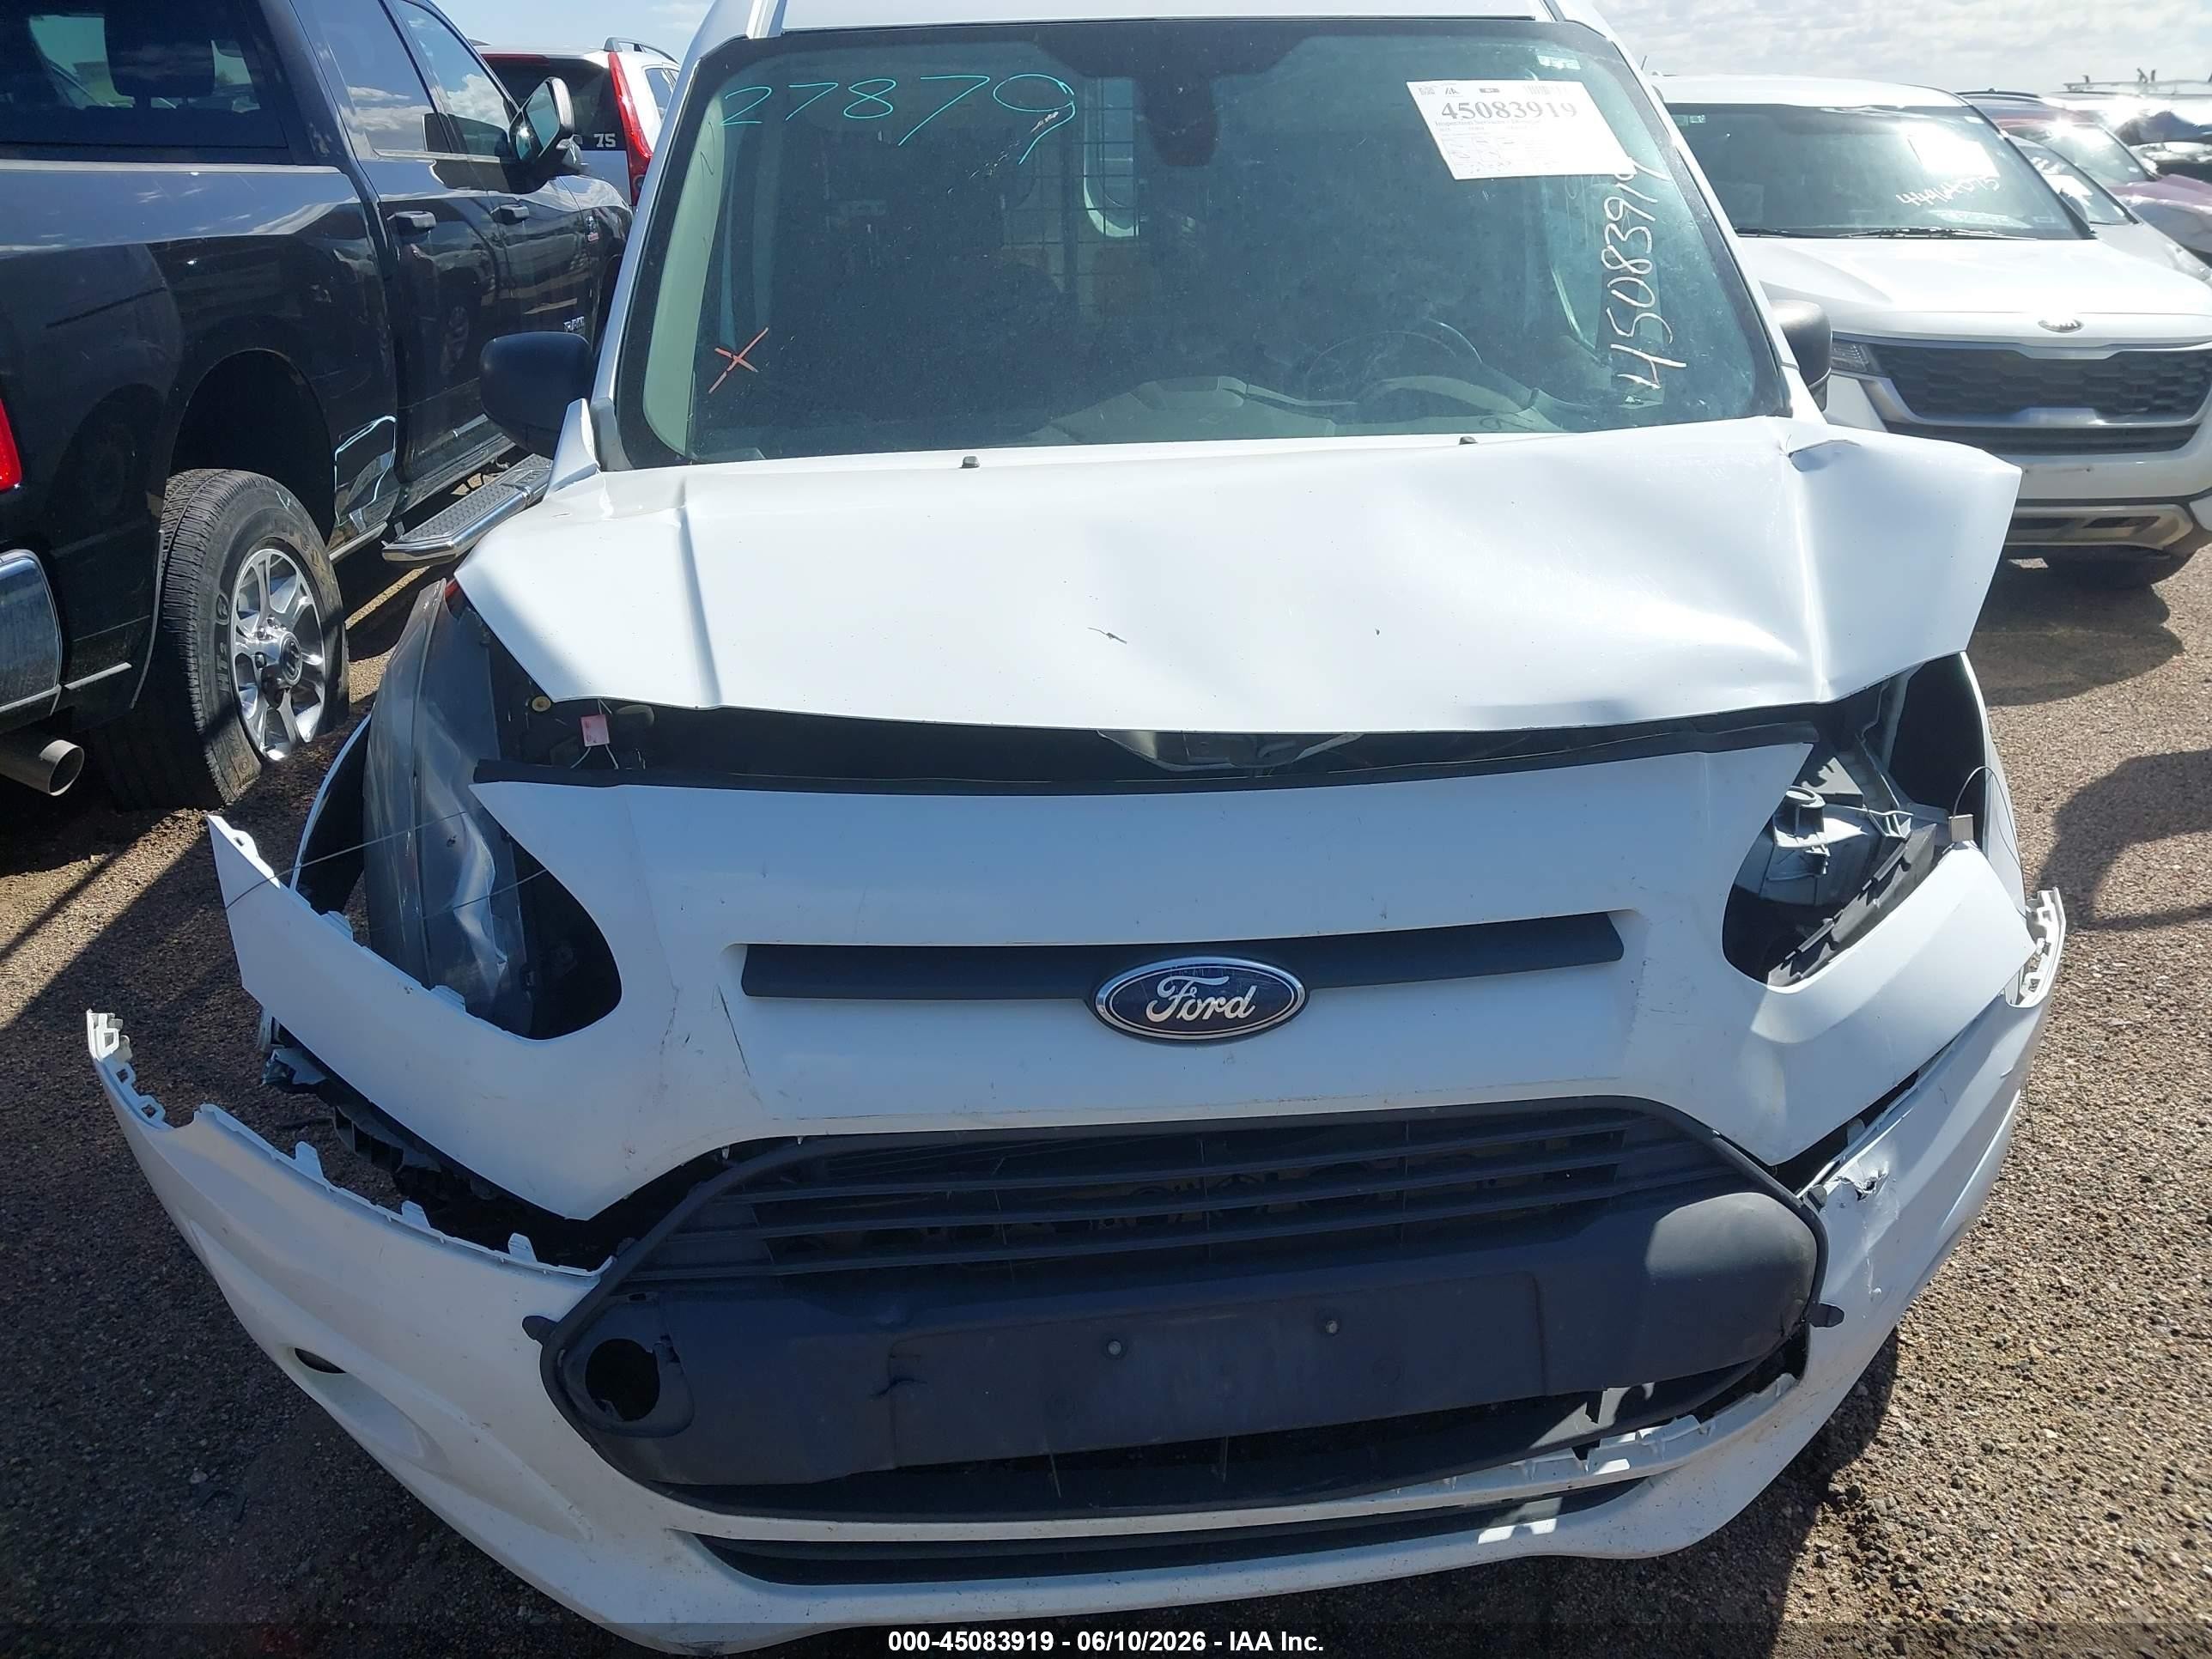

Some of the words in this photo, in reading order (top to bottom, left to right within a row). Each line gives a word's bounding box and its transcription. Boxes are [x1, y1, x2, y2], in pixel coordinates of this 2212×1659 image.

[720, 74, 1075, 165] 27879
[1442, 100, 1578, 119] 45083919
[593, 133, 617, 148] 75
[1146, 975, 1258, 1023] Ford
